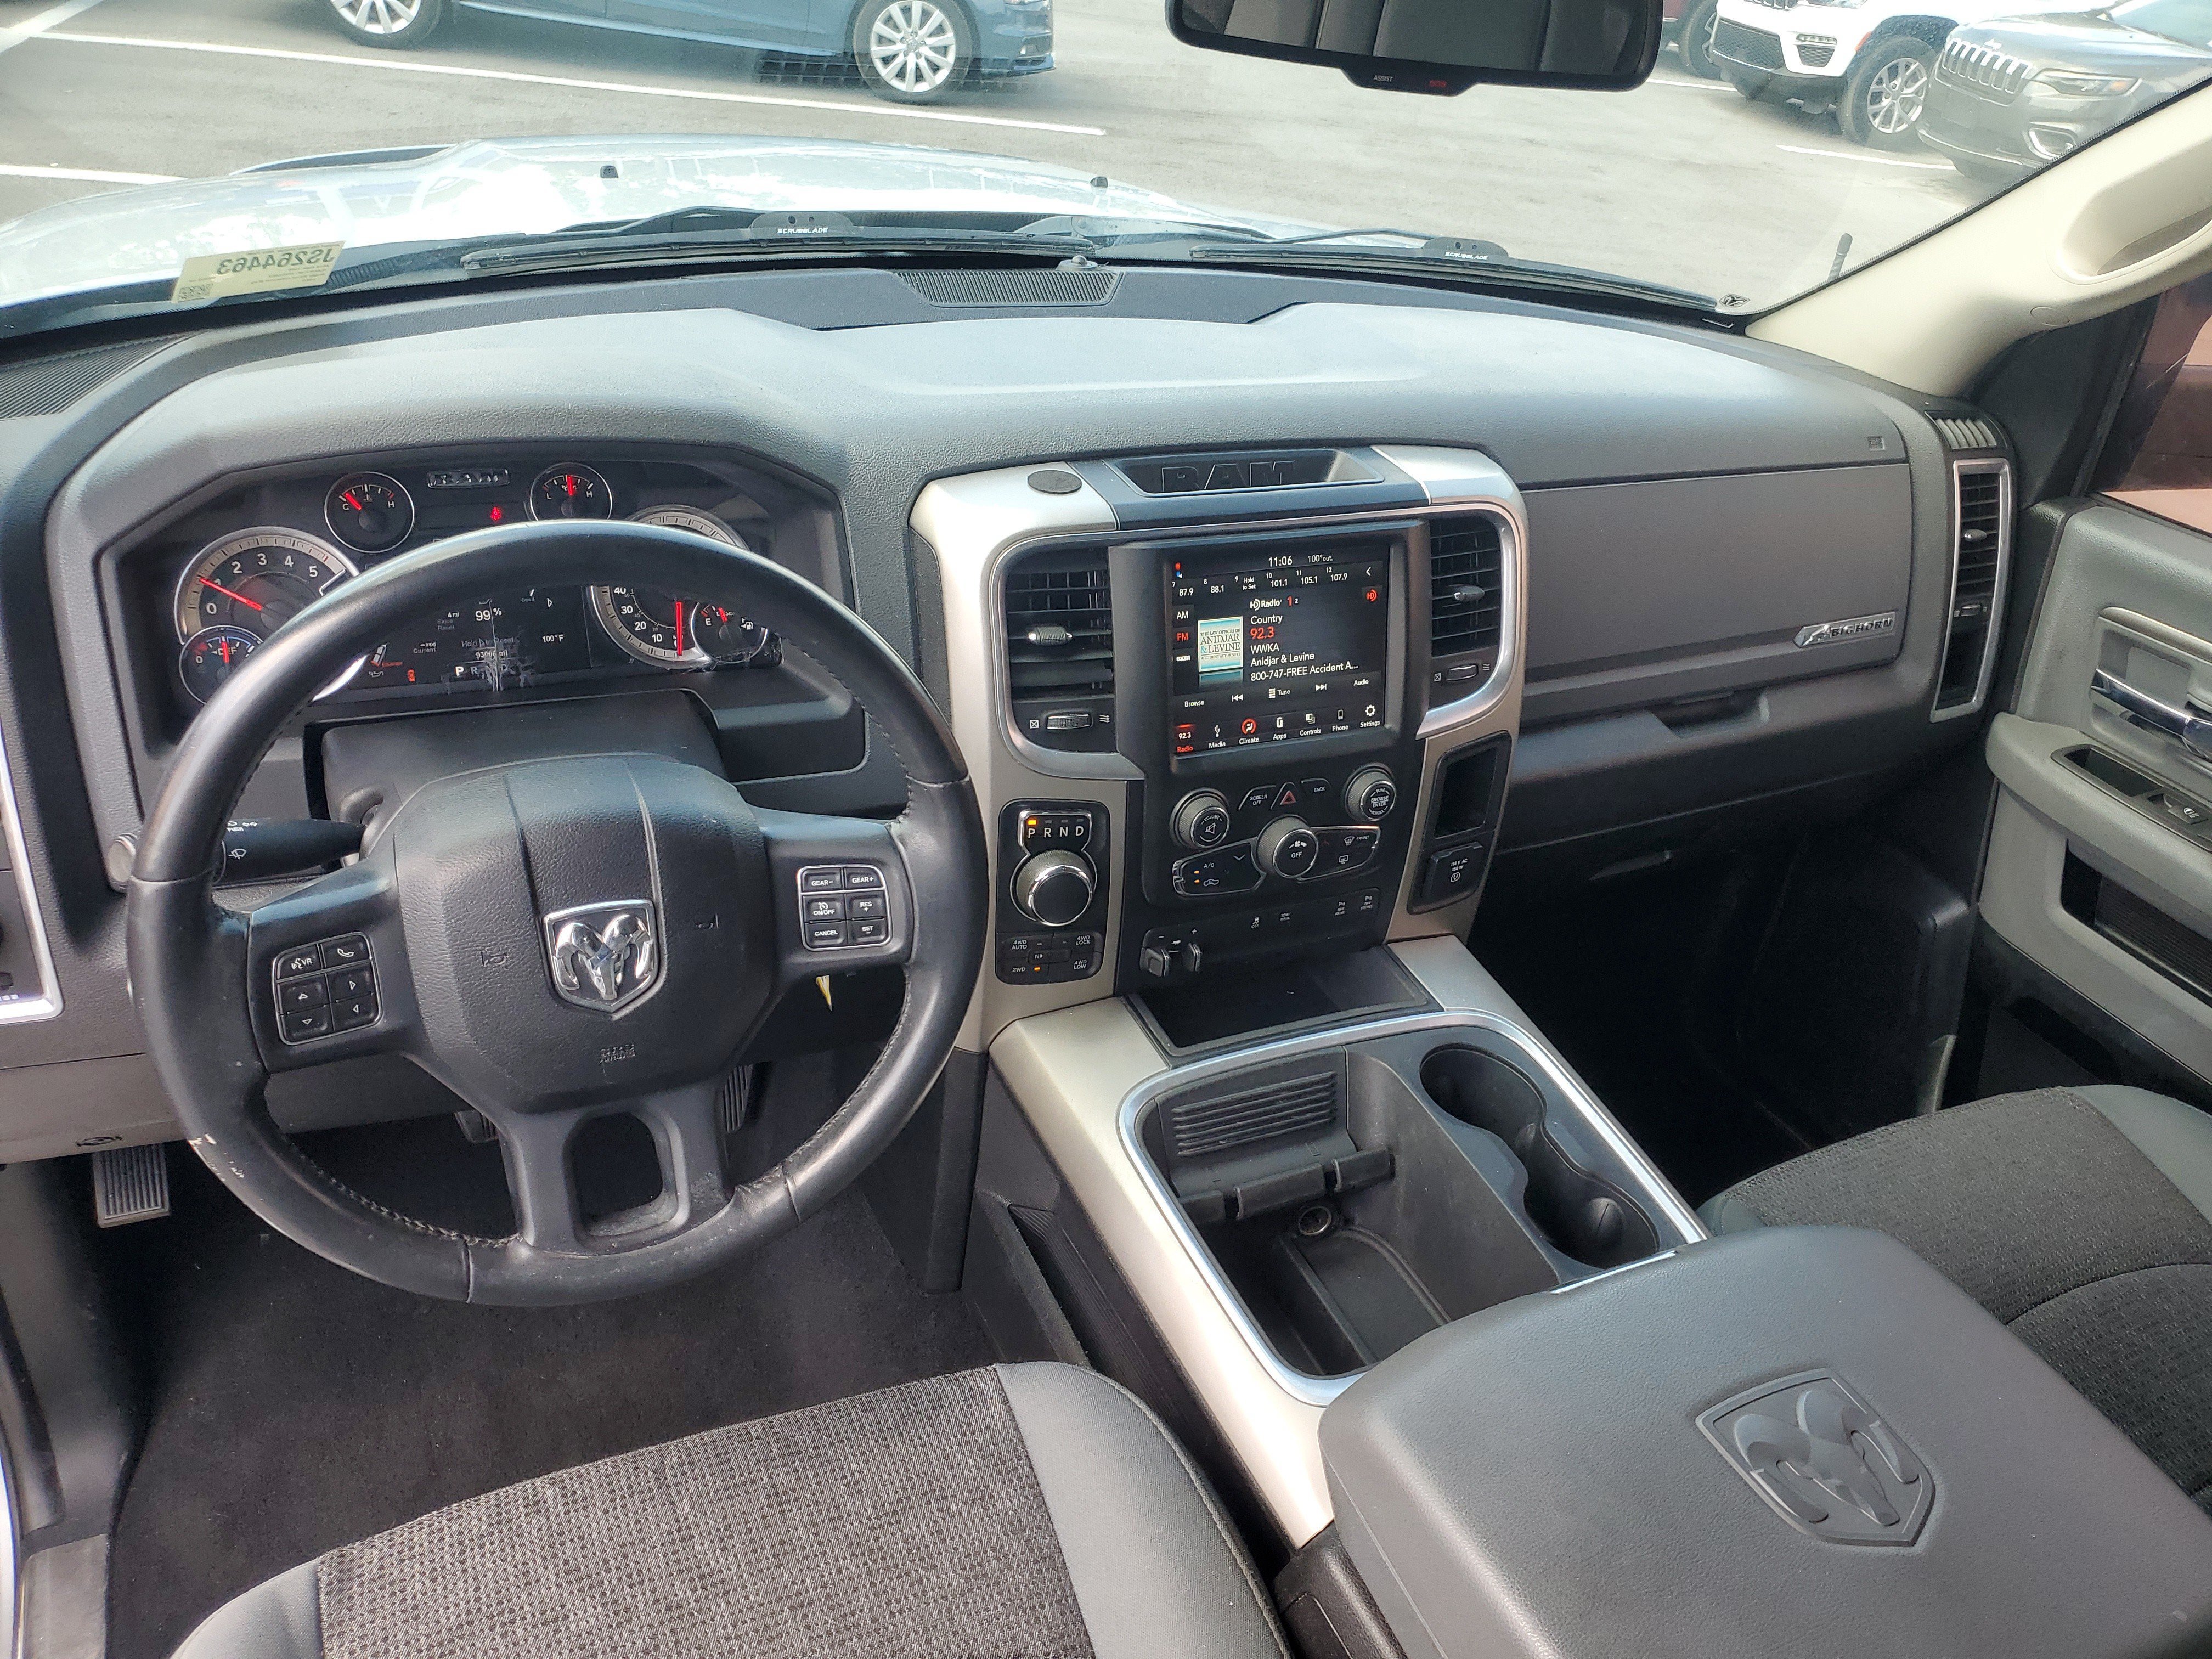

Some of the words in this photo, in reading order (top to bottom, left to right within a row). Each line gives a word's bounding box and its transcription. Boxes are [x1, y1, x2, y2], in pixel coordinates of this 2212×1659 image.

[1445, 251, 1488, 260] SCRUBBLADE
[1161, 460, 1295, 492] RAM
[257, 553, 267, 566] 3
[284, 555, 294, 567] 4
[1268, 556, 1293, 567] 11:06
[232, 561, 242, 573] 2
[309, 566, 318, 578] 5
[1243, 576, 1255, 584] Hold
[1301, 575, 1318, 585] 105.1
[1330, 573, 1348, 582] 107.9
[1271, 579, 1288, 588] 101.1
[1179, 588, 1194, 596] 87.9
[1210, 585, 1224, 594] 88.1
[1287, 596, 1293, 606] 1
[206, 602, 217, 615] 0
[620, 606, 633, 614] 30
[475, 610, 490, 621] 99
[1176, 610, 1189, 620] AM
[1250, 614, 1283, 625] Country
[635, 621, 646, 631] 20
[706, 618, 712, 626] E
[1177, 632, 1189, 642] FM
[1250, 626, 1275, 640] 92.3
[651, 634, 663, 643] 10
[1200, 634, 1240, 645] ANIDJAR
[1209, 642, 1240, 653] LEVINE
[1250, 643, 1279, 653] WWKA
[1250, 657, 1279, 668] Anidjar
[1281, 654, 1287, 663] &
[1289, 652, 1314, 662] Levine
[455, 666, 464, 676] P
[1251, 667, 1308, 681] 800-747-FREE
[1310, 662, 1343, 675] Accident
[1184, 699, 1204, 708] Browse
[1332, 724, 1348, 732] Phone
[1359, 719, 1380, 728] Settings
[1273, 732, 1286, 741] Apps
[1299, 727, 1321, 736] Controls
[1209, 740, 1226, 748] Media
[1239, 736, 1259, 744] Climate
[1177, 744, 1193, 753] Radio
[1028, 827, 1036, 838] P
[1043, 827, 1052, 838] R
[1059, 826, 1068, 837] N
[1075, 825, 1084, 836] D
[302, 957, 313, 966] VR
